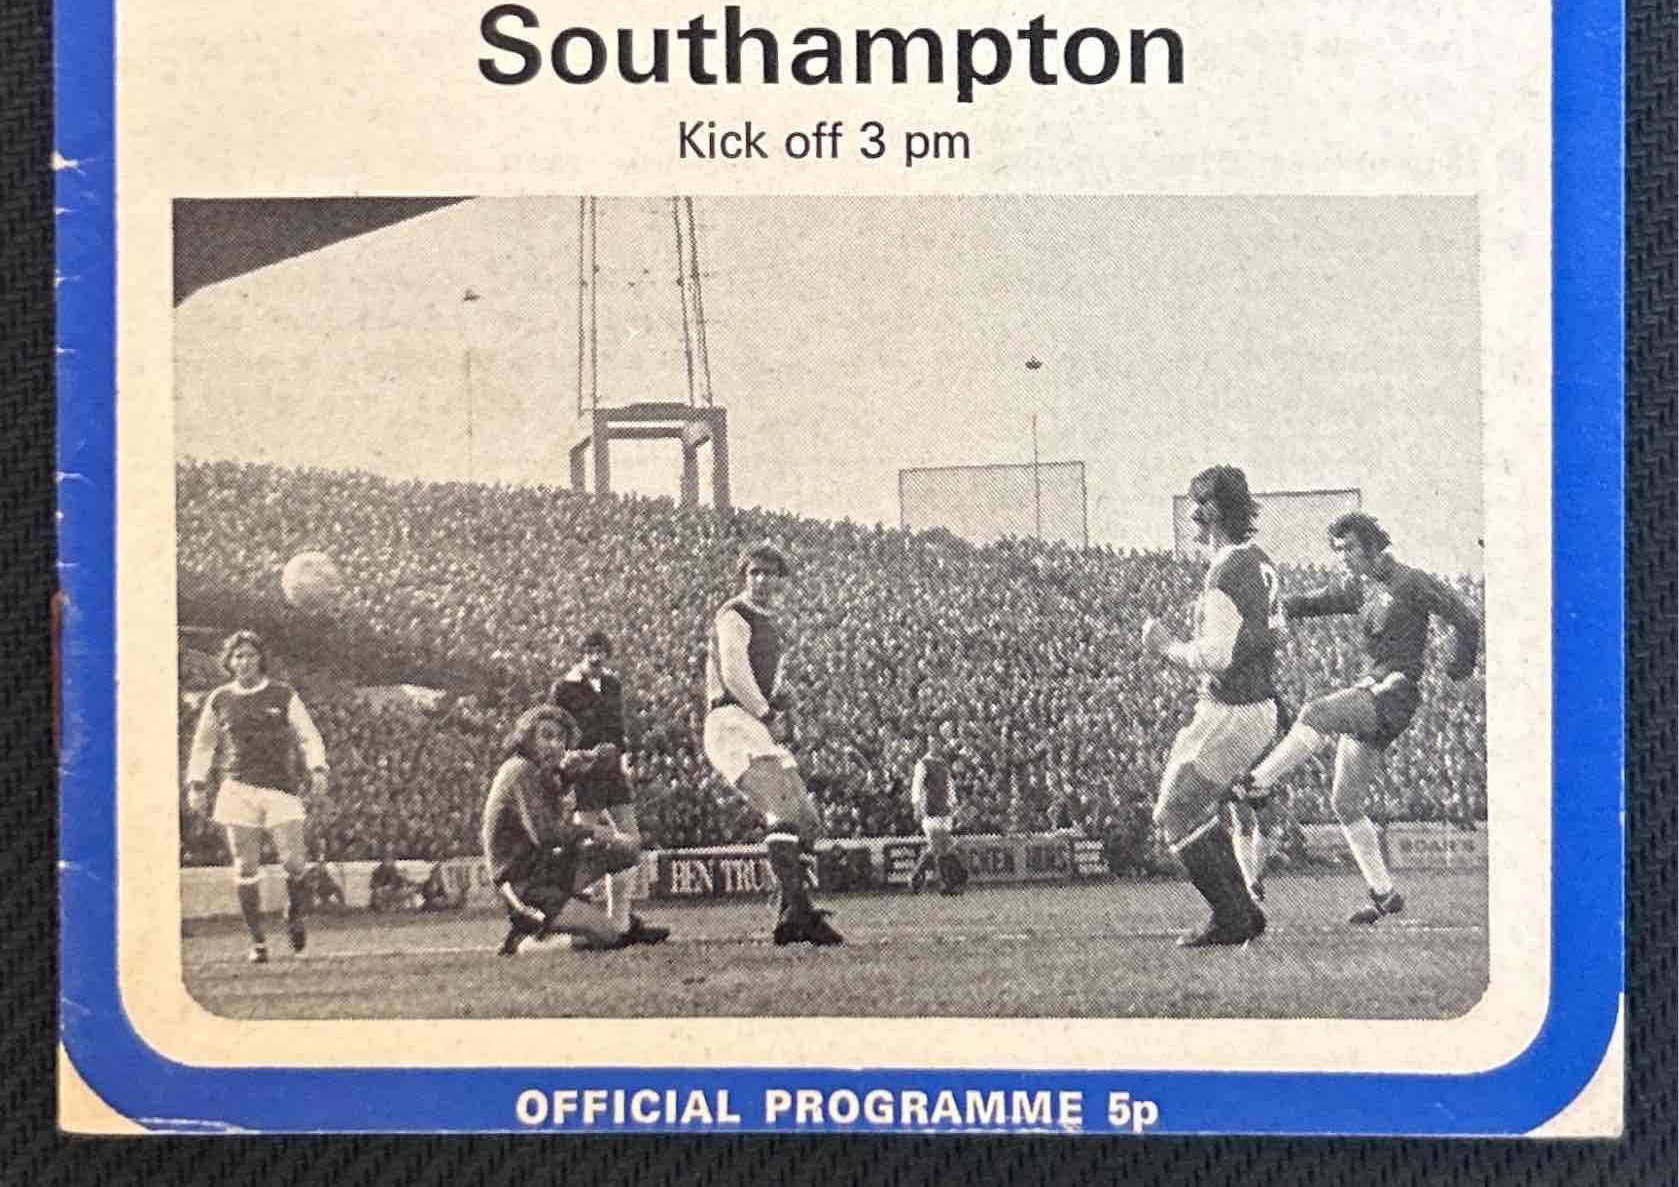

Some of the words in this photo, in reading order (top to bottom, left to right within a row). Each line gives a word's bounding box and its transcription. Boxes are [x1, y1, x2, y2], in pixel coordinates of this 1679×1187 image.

[479, 4, 1183, 103] Southampton
[680, 122, 768, 159] Kick
[786, 121, 842, 159] off
[861, 122, 886, 159] 3
[905, 131, 970, 168] pm
[515, 1088, 741, 1127] OFFICIAL
[765, 1089, 1083, 1129] PROGRAMME
[1107, 1090, 1160, 1133] 5p
